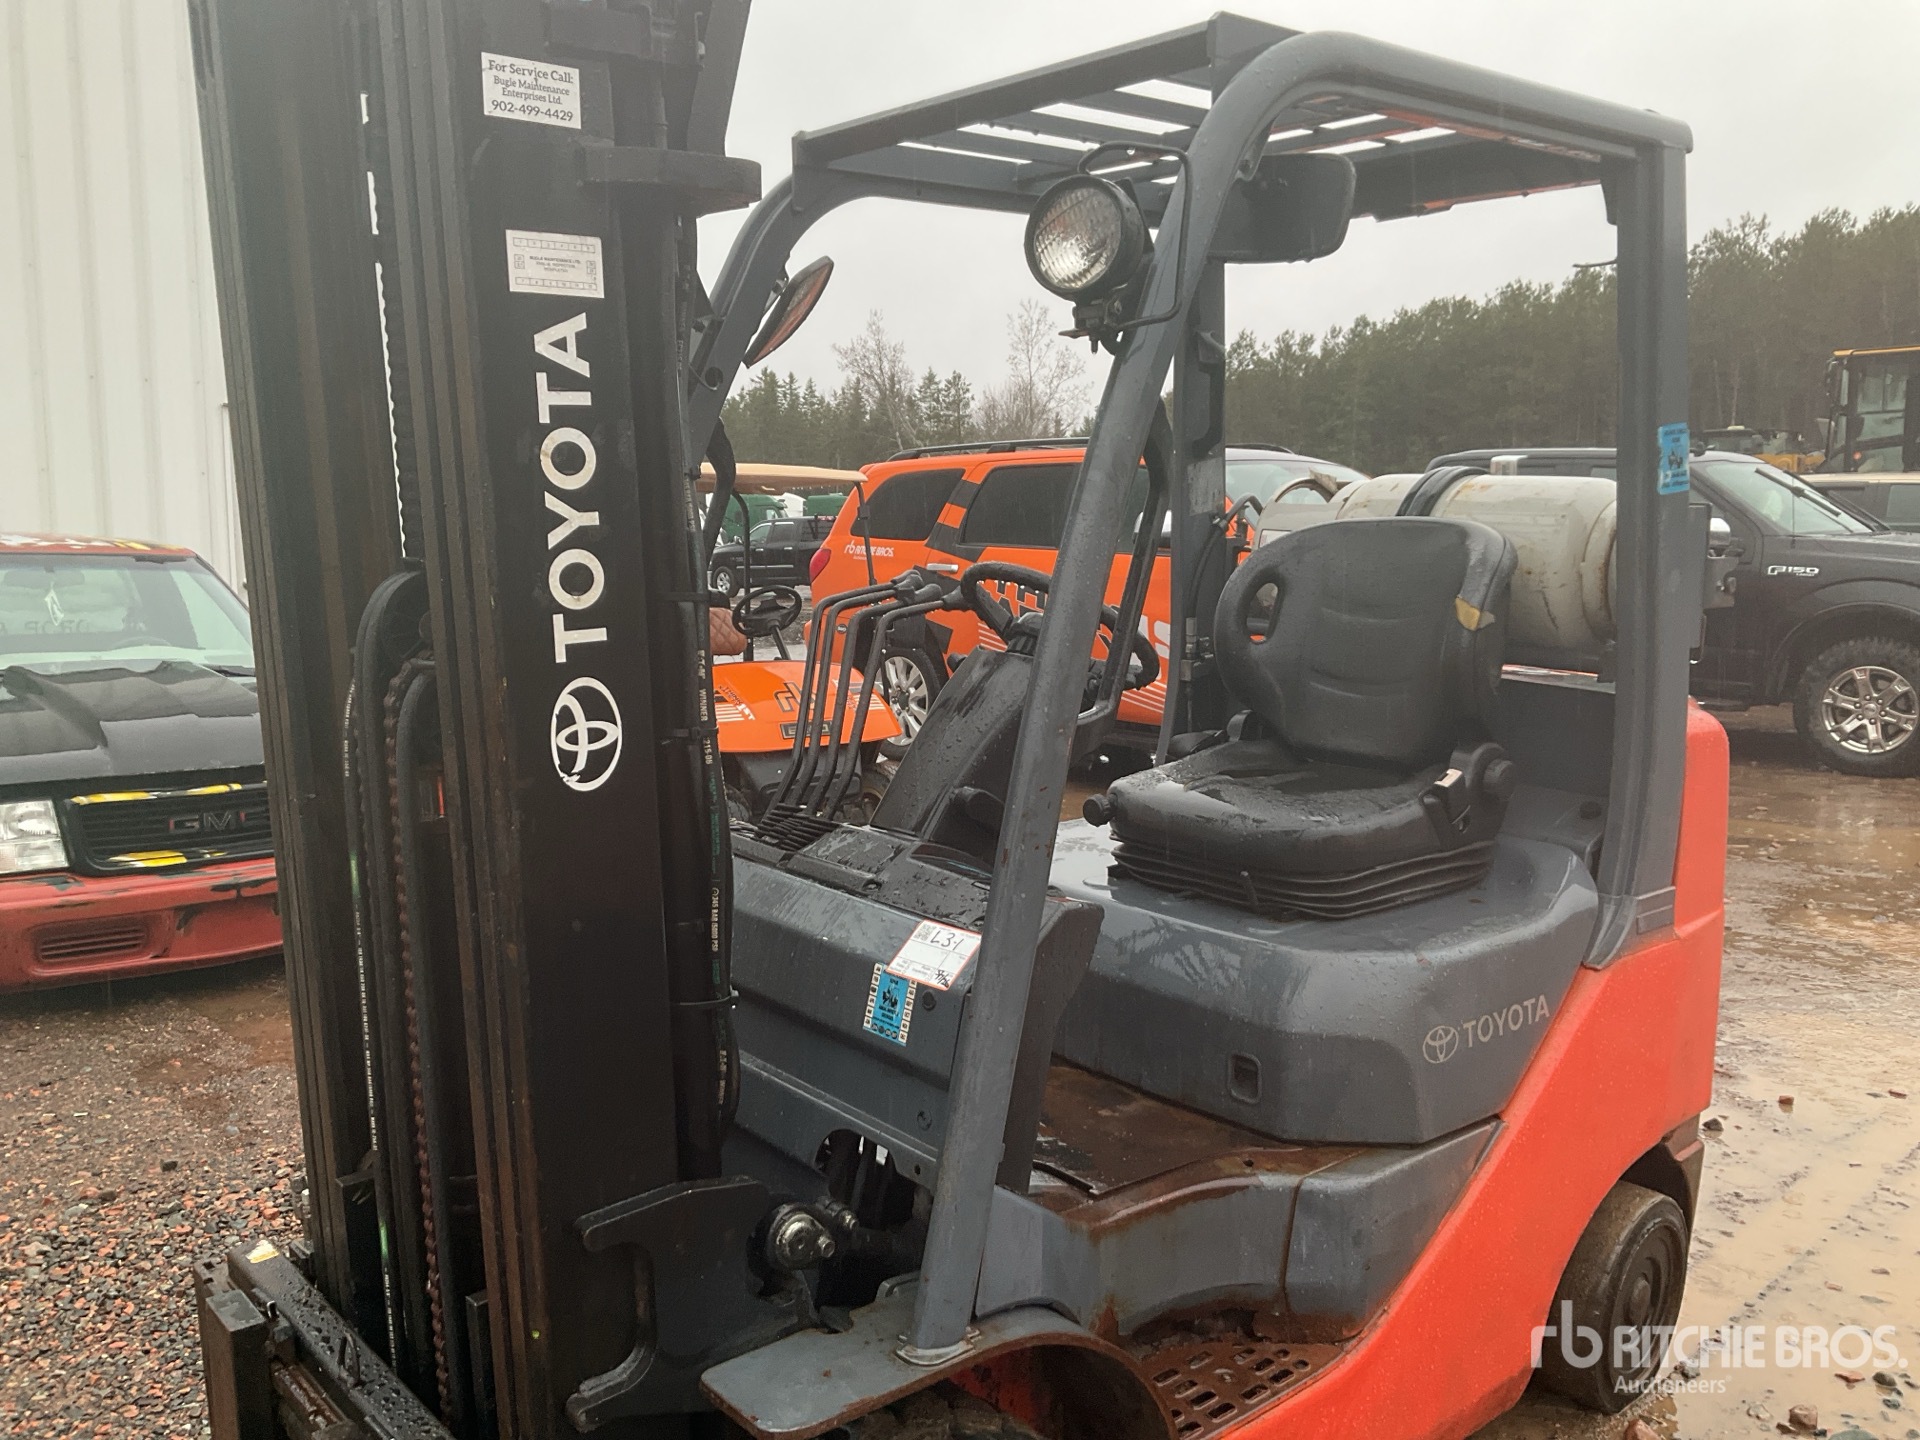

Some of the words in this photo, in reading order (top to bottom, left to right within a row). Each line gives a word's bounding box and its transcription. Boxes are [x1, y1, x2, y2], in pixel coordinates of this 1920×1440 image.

[488, 59, 508, 73] For
[509, 63, 549, 80] Service
[550, 70, 574, 84] Call:
[493, 75, 517, 88] Bugle
[518, 78, 570, 96] Maintenance
[502, 87, 547, 103] Enterprises
[548, 94, 563, 105] Ltd.
[491, 99, 573, 122] 902-499-4429
[533, 312, 608, 664] TOYOTA
[698, 688, 708, 721] WINNER
[711, 909, 719, 922] BAR
[1463, 994, 1550, 1048] TOYOTA
